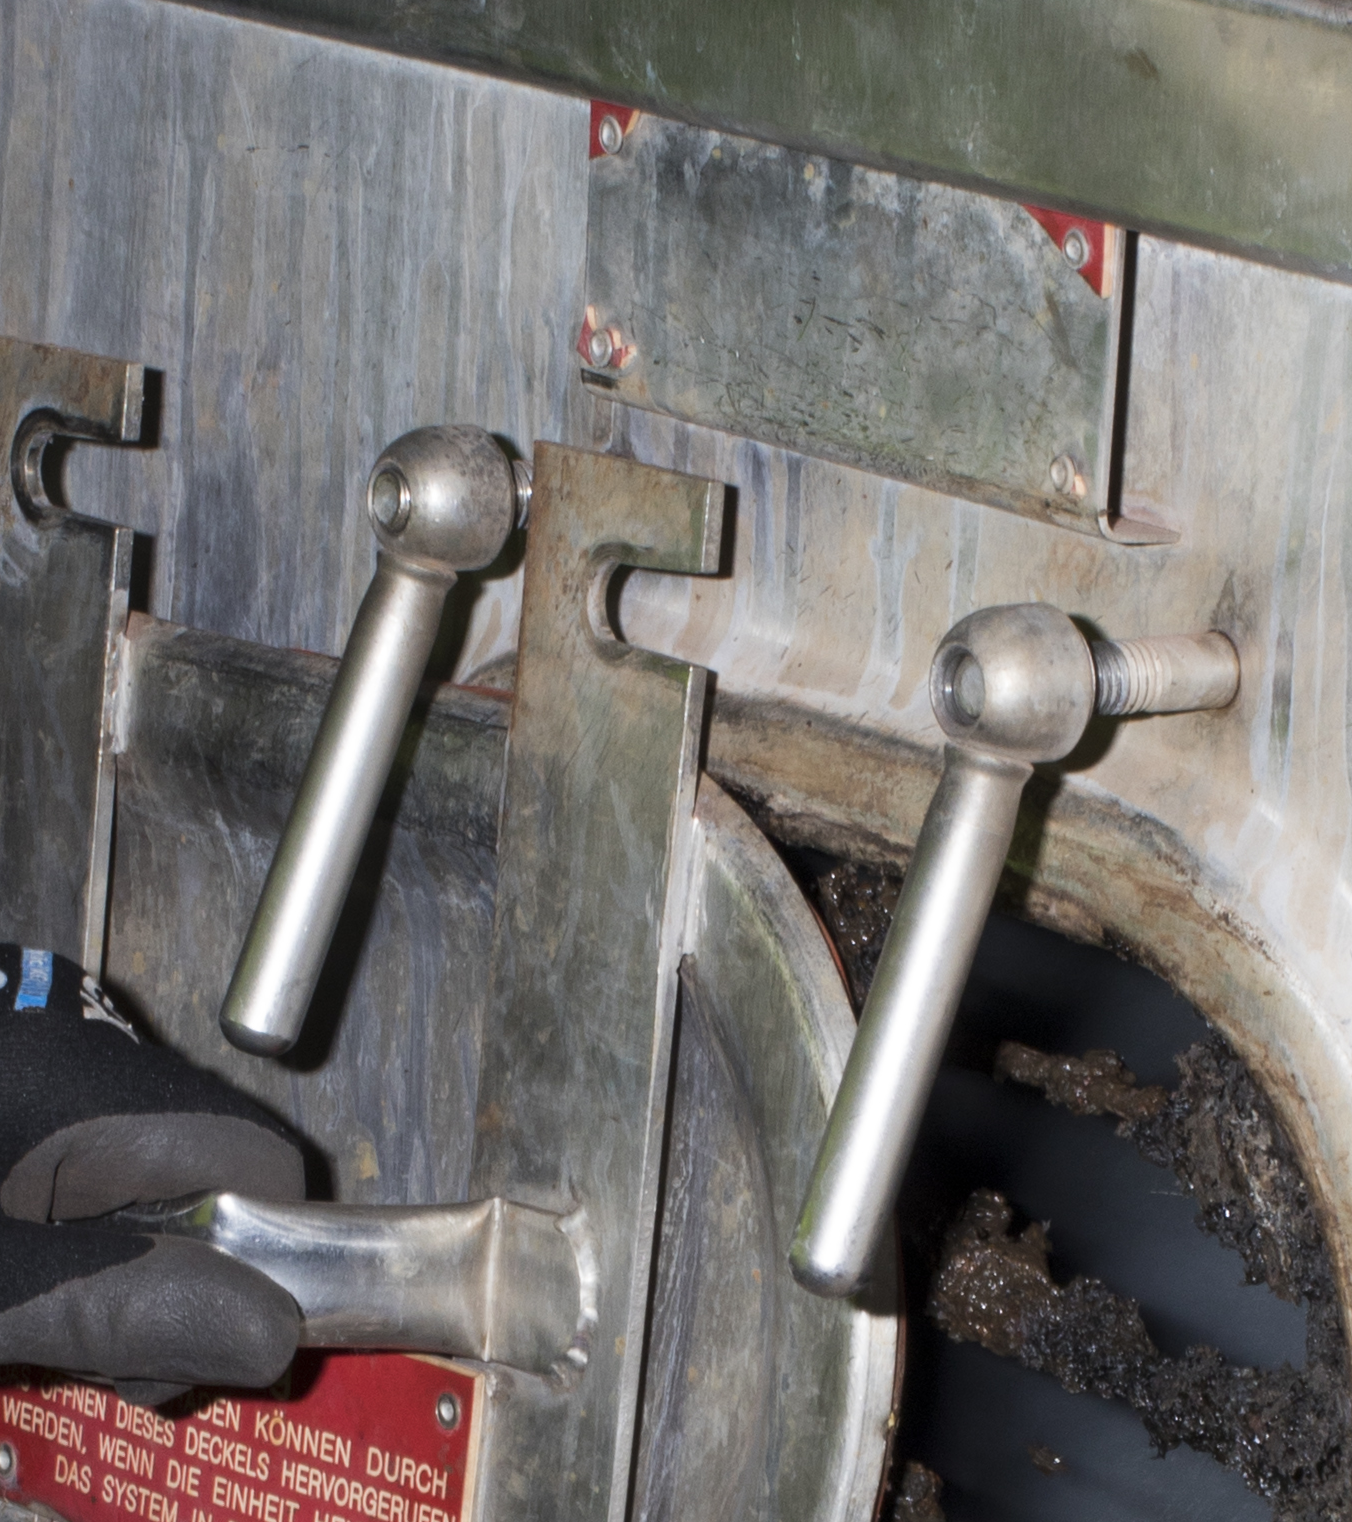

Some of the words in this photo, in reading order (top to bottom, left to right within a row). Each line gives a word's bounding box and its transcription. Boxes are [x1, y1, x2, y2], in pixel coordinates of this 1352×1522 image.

[4, 1396, 87, 1455] WERDEN,
[100, 1433, 155, 1480] WENN
[167, 1459, 202, 1498] DIE
[55, 1455, 92, 1494] DAS
[116, 1400, 175, 1447] DIESES
[185, 1426, 270, 1482] DECKELS
[255, 1409, 351, 1469] KÖNNEN
[366, 1447, 448, 1500] DURCH
